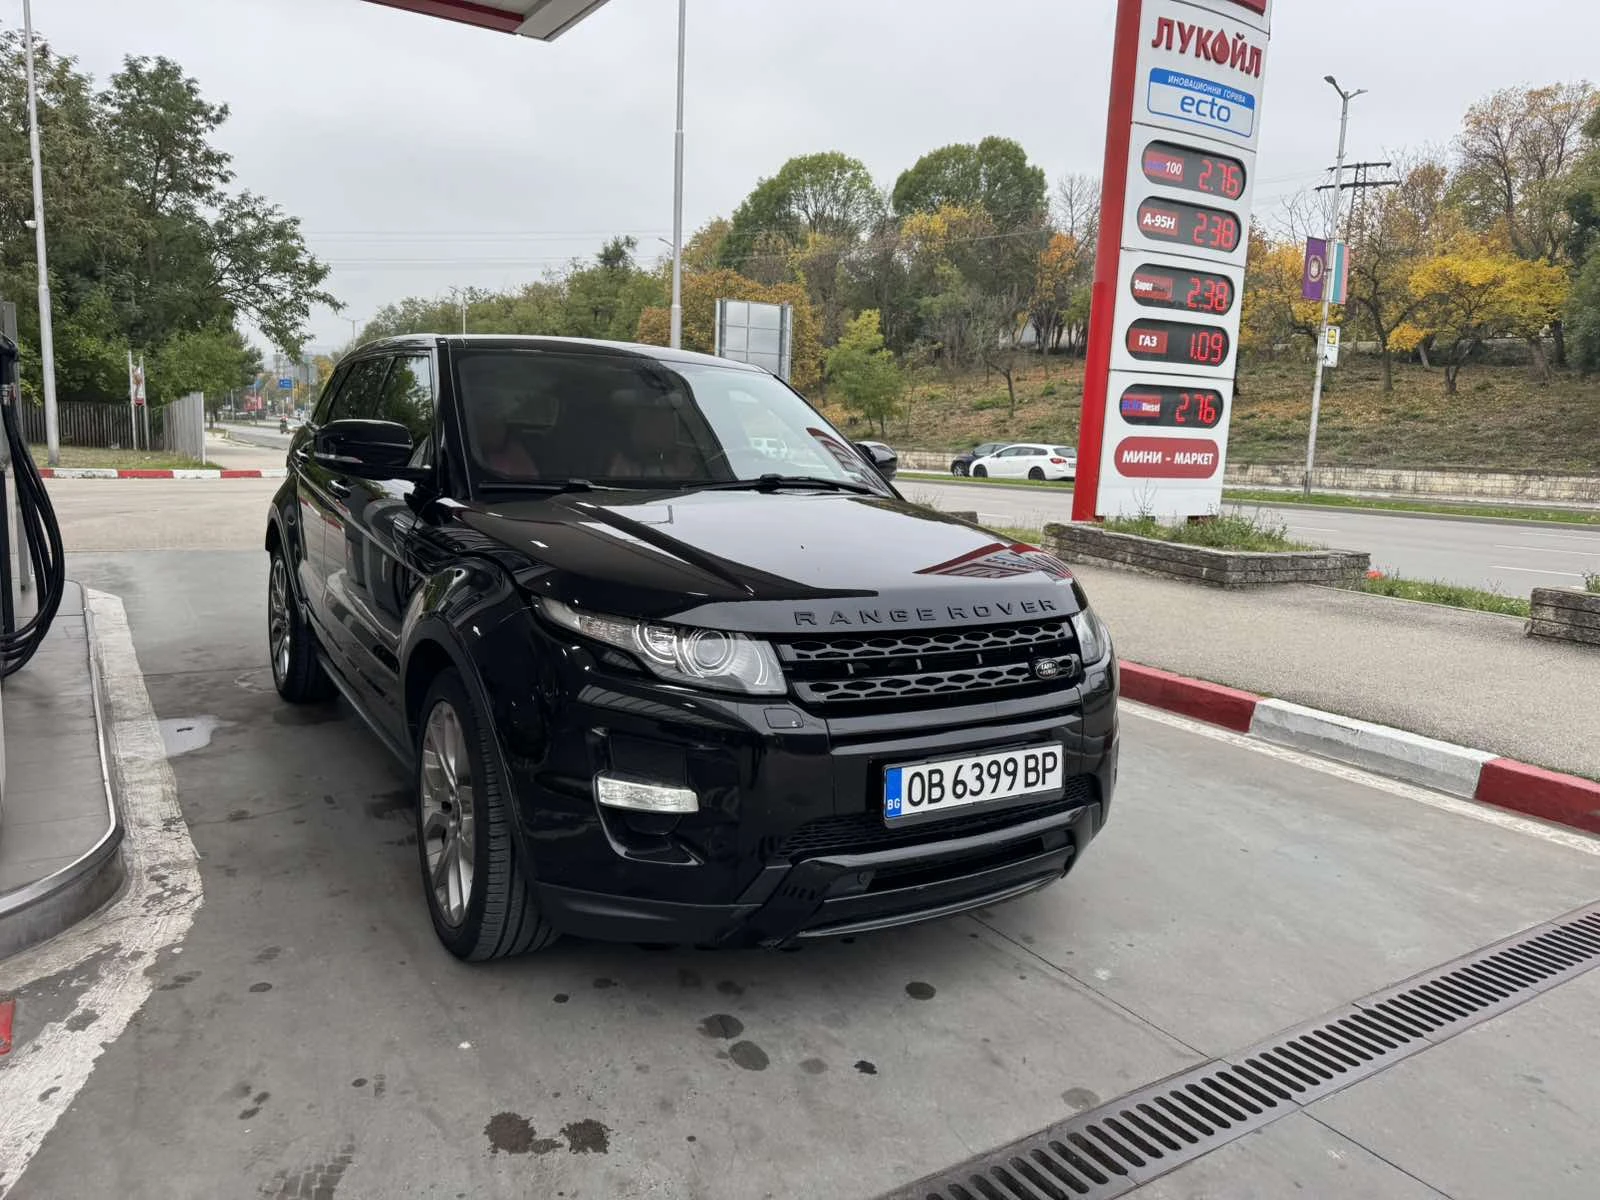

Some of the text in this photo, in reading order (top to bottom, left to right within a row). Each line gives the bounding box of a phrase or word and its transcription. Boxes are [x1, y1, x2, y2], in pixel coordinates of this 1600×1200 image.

[1180, 95, 1231, 122] ecto
[1165, 160, 1183, 175] 100
[1138, 334, 1158, 347] ГАЗ
[1121, 450, 1163, 464] МИНИ
[1173, 451, 1214, 465] МАРКЕТ
[793, 599, 1057, 626] RANGE ROVER
[907, 751, 1058, 807] OB 6399 BP
[886, 798, 900, 810] BG
